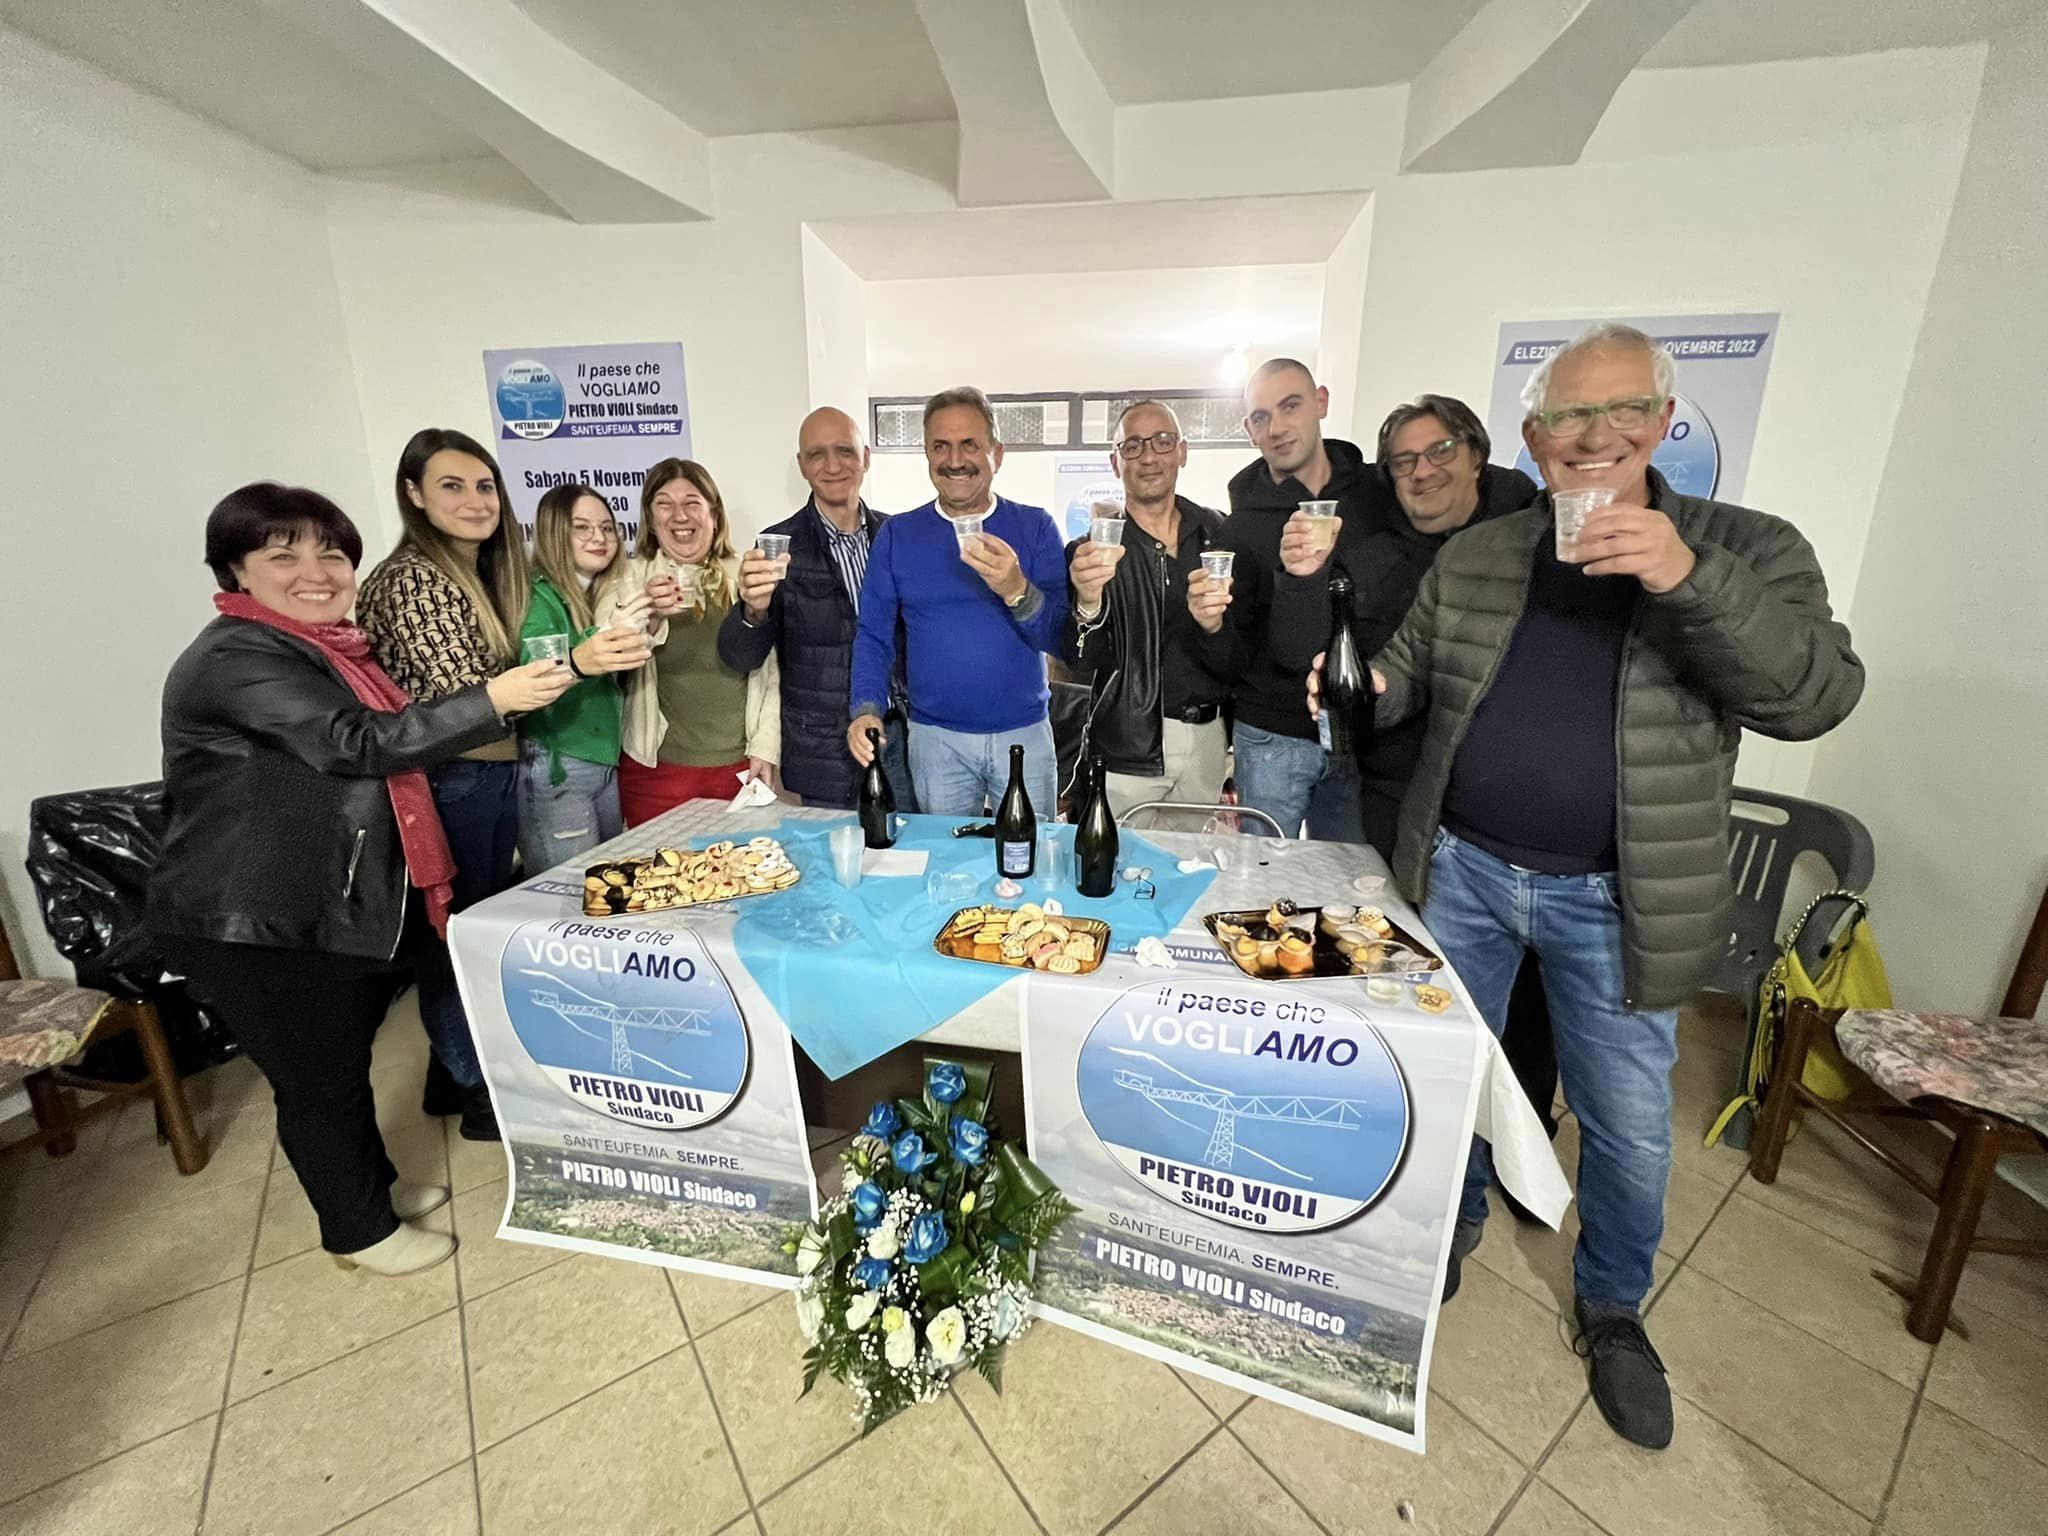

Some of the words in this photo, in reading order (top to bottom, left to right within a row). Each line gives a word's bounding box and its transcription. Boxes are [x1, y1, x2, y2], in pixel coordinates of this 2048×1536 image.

[1664, 340, 1726, 355] OVEMBRE
[1726, 340, 1757, 353] 2022
[580, 381, 661, 397] VOGLIAMO
[590, 364, 631, 380] paese
[636, 361, 660, 376] che
[569, 403, 605, 418] PIETRO
[607, 402, 634, 416] VIOLI
[636, 402, 679, 416] Sindaco
[638, 422, 680, 434] SEMPRE.
[524, 469, 576, 489] Sabato
[580, 469, 590, 487] 5
[593, 468, 649, 487] Novem
[562, 922, 632, 939] paese
[635, 929, 675, 946] che
[524, 937, 697, 983] VOGLIAMO
[1157, 986, 1172, 1006] il
[1177, 991, 1267, 1017] paese
[1276, 1001, 1326, 1024] che
[1124, 1011, 1359, 1067] VOGLIAMO
[569, 1074, 643, 1103] PIETRO
[645, 1086, 704, 1113] VIOLI
[608, 1102, 675, 1124] Sindaco
[563, 1134, 674, 1161] SANT'EUFEMIA.
[677, 1150, 745, 1172] SEMPRE.
[562, 1160, 627, 1188] PIETRO
[628, 1169, 680, 1197] VIOLI
[683, 1180, 757, 1209] Sindaco
[1140, 1156, 1235, 1198] PIETRO
[1242, 1182, 1318, 1219] VIOLI
[1181, 1190, 1267, 1226] Sindaco
[1109, 1212, 1245, 1265] SANT'EUFEMIA.
[1251, 1253, 1340, 1290] SEMPRE.
[1096, 1238, 1176, 1281] PIETRO
[1181, 1263, 1244, 1303] VIOLI
[1249, 1287, 1346, 1336] Sindaco
